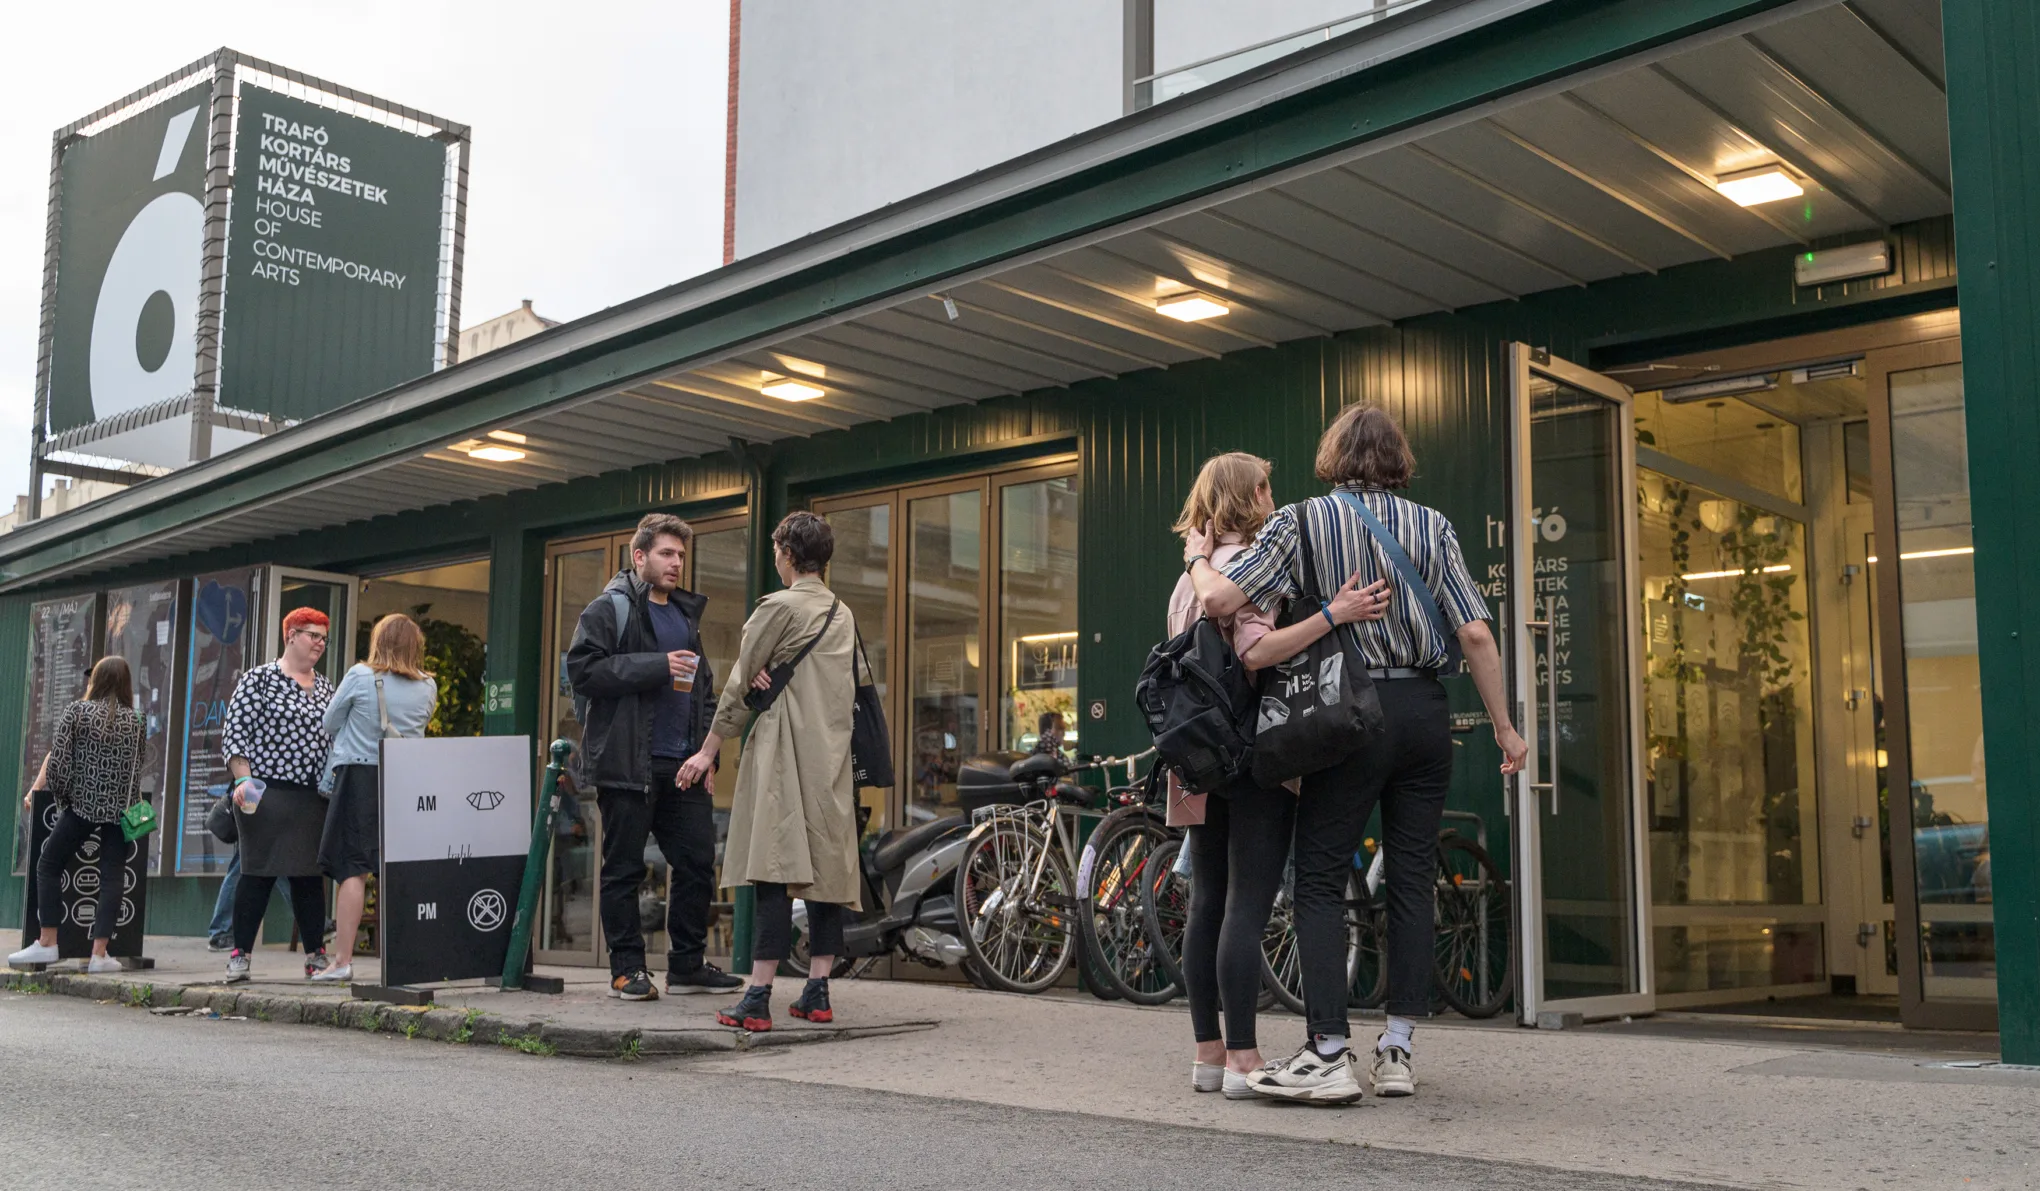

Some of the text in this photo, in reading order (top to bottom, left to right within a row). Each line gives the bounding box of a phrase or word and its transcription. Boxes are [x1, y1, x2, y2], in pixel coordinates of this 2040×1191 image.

[261, 113, 329, 146] TRAFÓ
[260, 133, 351, 173] KORTÁRS
[257, 175, 315, 205] HÁZA
[259, 154, 388, 205] MŰVÉSZETEK
[254, 218, 282, 237] OF
[256, 196, 322, 228] HOUSE
[251, 260, 300, 286] ARTS
[253, 239, 406, 290] CONTEMPORARY
[1486, 506, 1567, 549] trfó
[417, 795, 437, 811] AM
[417, 902, 437, 920] PM
